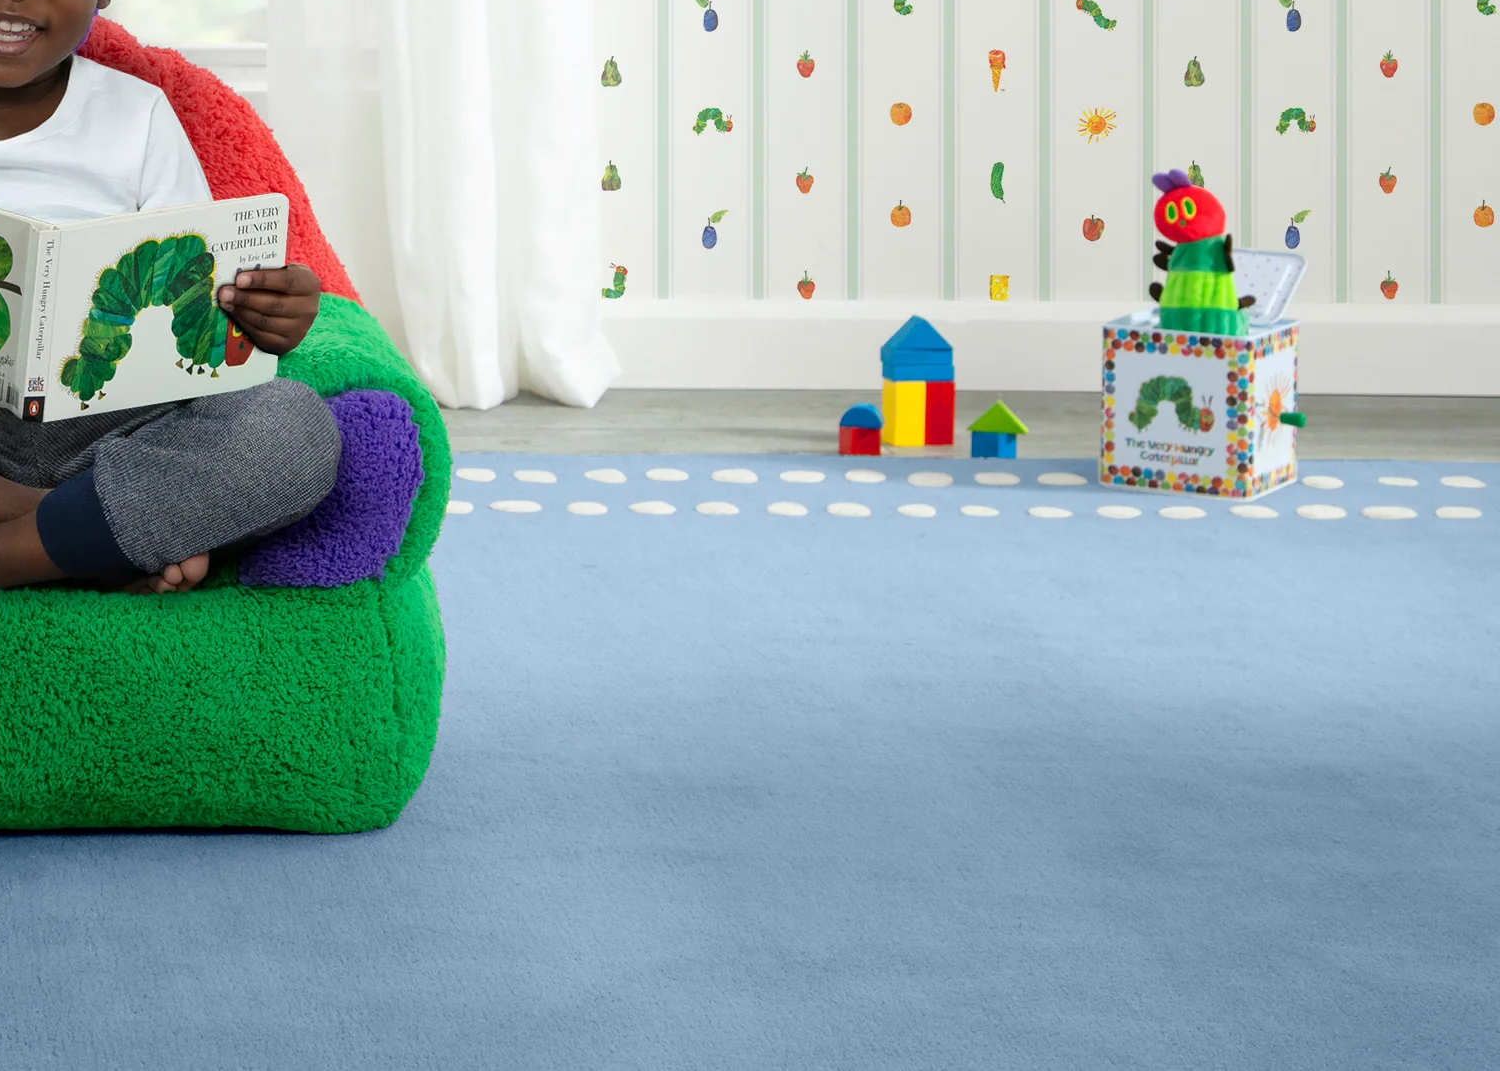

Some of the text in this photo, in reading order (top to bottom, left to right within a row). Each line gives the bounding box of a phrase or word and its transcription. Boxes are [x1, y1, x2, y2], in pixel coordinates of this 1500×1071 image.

[233, 206, 281, 222] THE VERY
[237, 220, 280, 235] HUNGRY
[211, 235, 278, 253] CATERPILLAR
[239, 251, 277, 264] by Eric Carle
[35, 239, 54, 360] The Very Hungry Caterpillar
[28, 378, 44, 388] ERIC
[1125, 437, 1215, 457] The Very Hungry
[1140, 450, 1200, 466] Caterpillar
